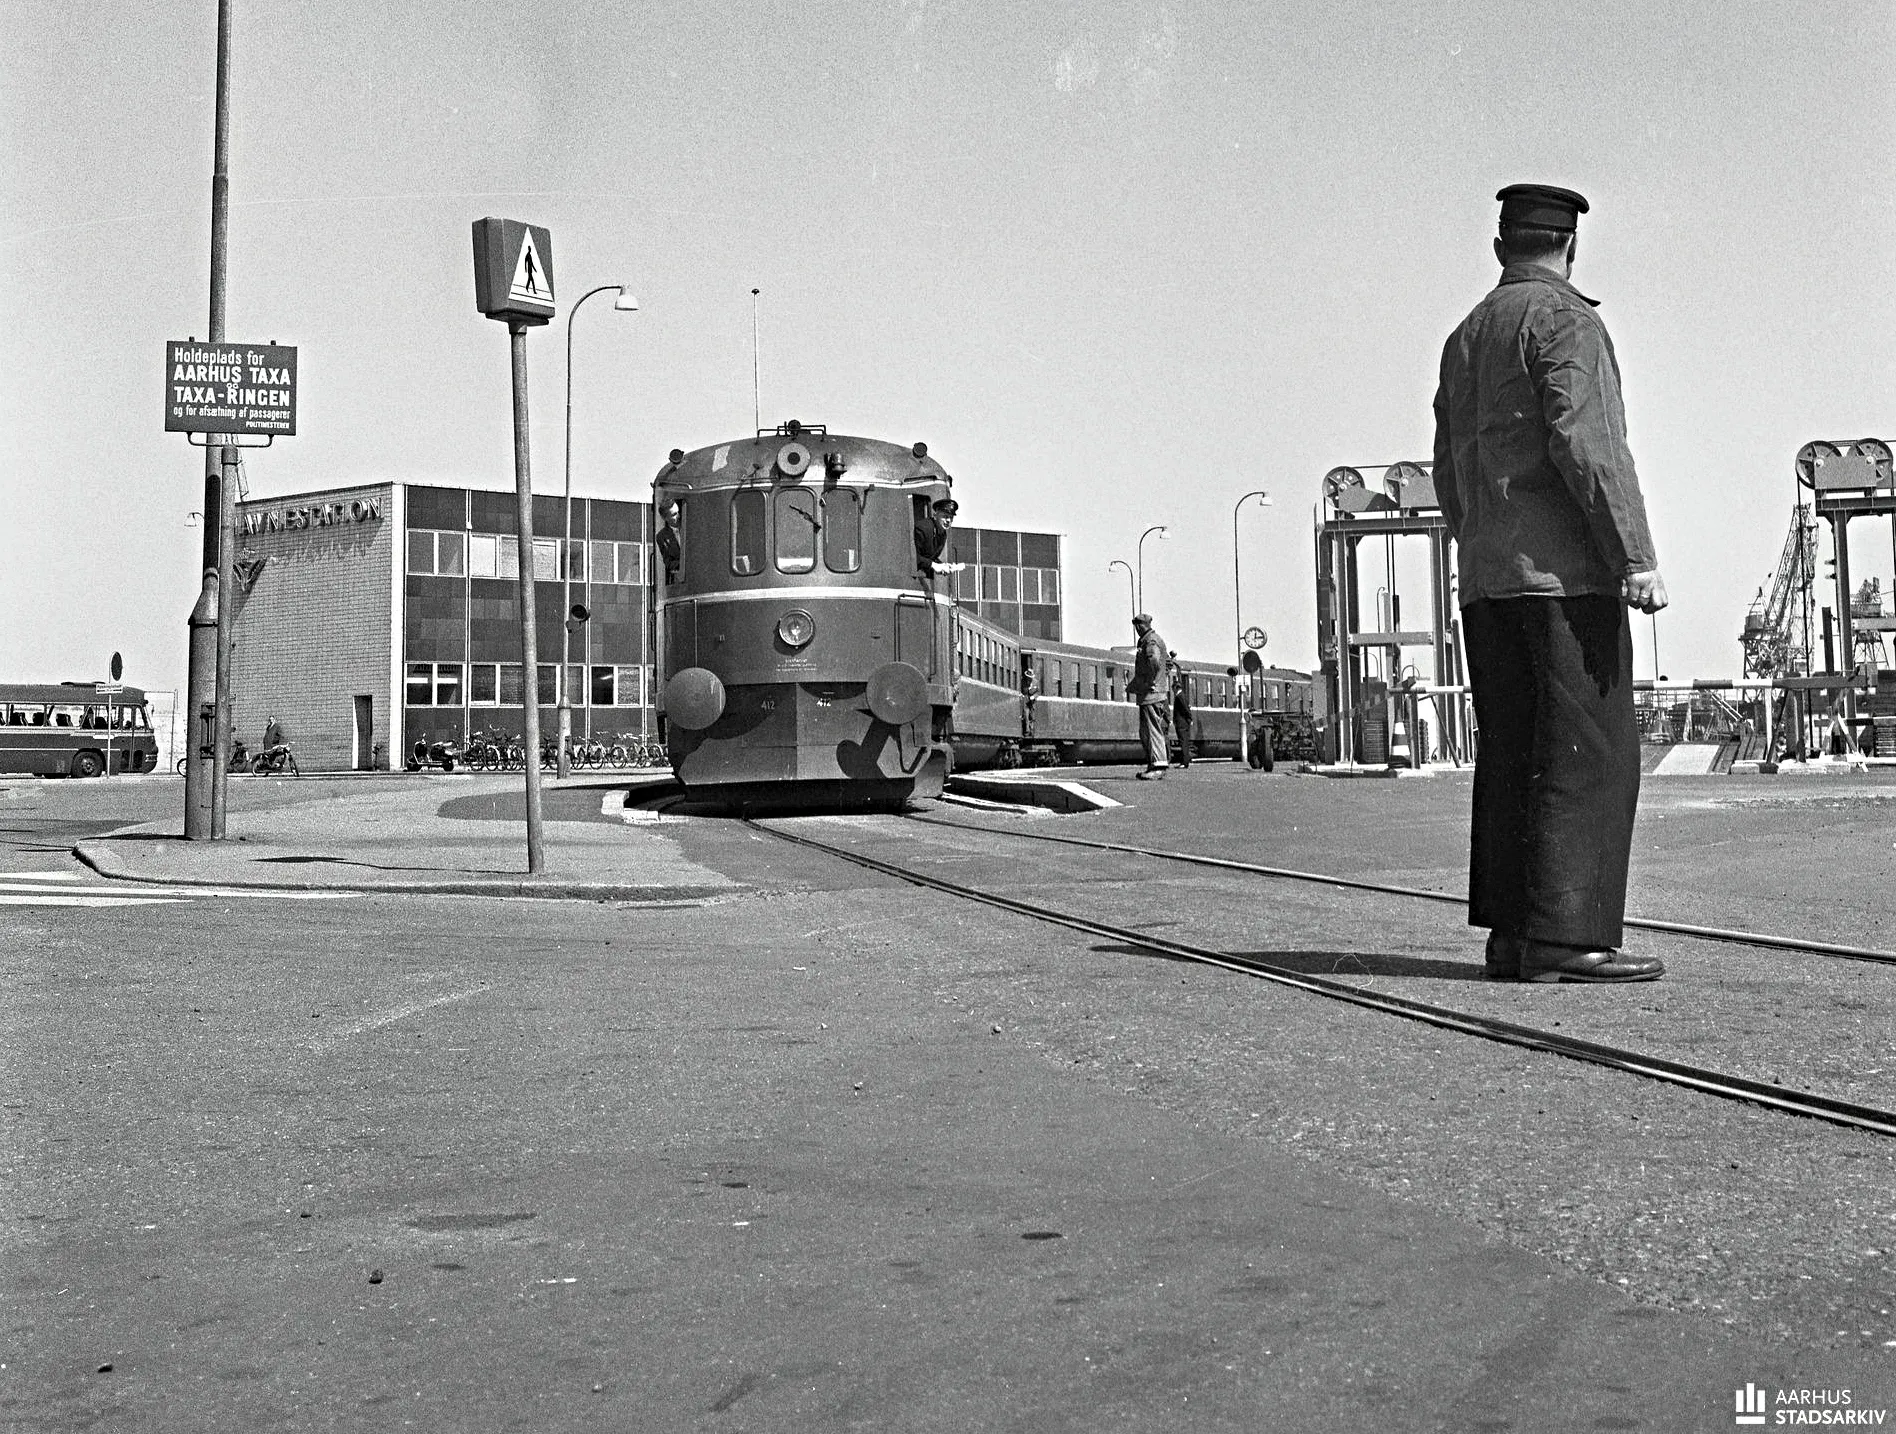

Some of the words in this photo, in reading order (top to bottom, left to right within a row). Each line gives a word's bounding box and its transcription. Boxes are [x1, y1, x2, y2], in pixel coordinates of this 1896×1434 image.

[174, 347, 242, 365] Holdeplads
[247, 350, 265, 365] for
[173, 364, 242, 383] AARHUS
[249, 367, 291, 385] TAXA
[173, 406, 183, 417] og
[186, 404, 197, 416] for
[238, 407, 248, 418] af
[249, 409, 290, 421] passagerer
[761, 700, 775, 711] 412
